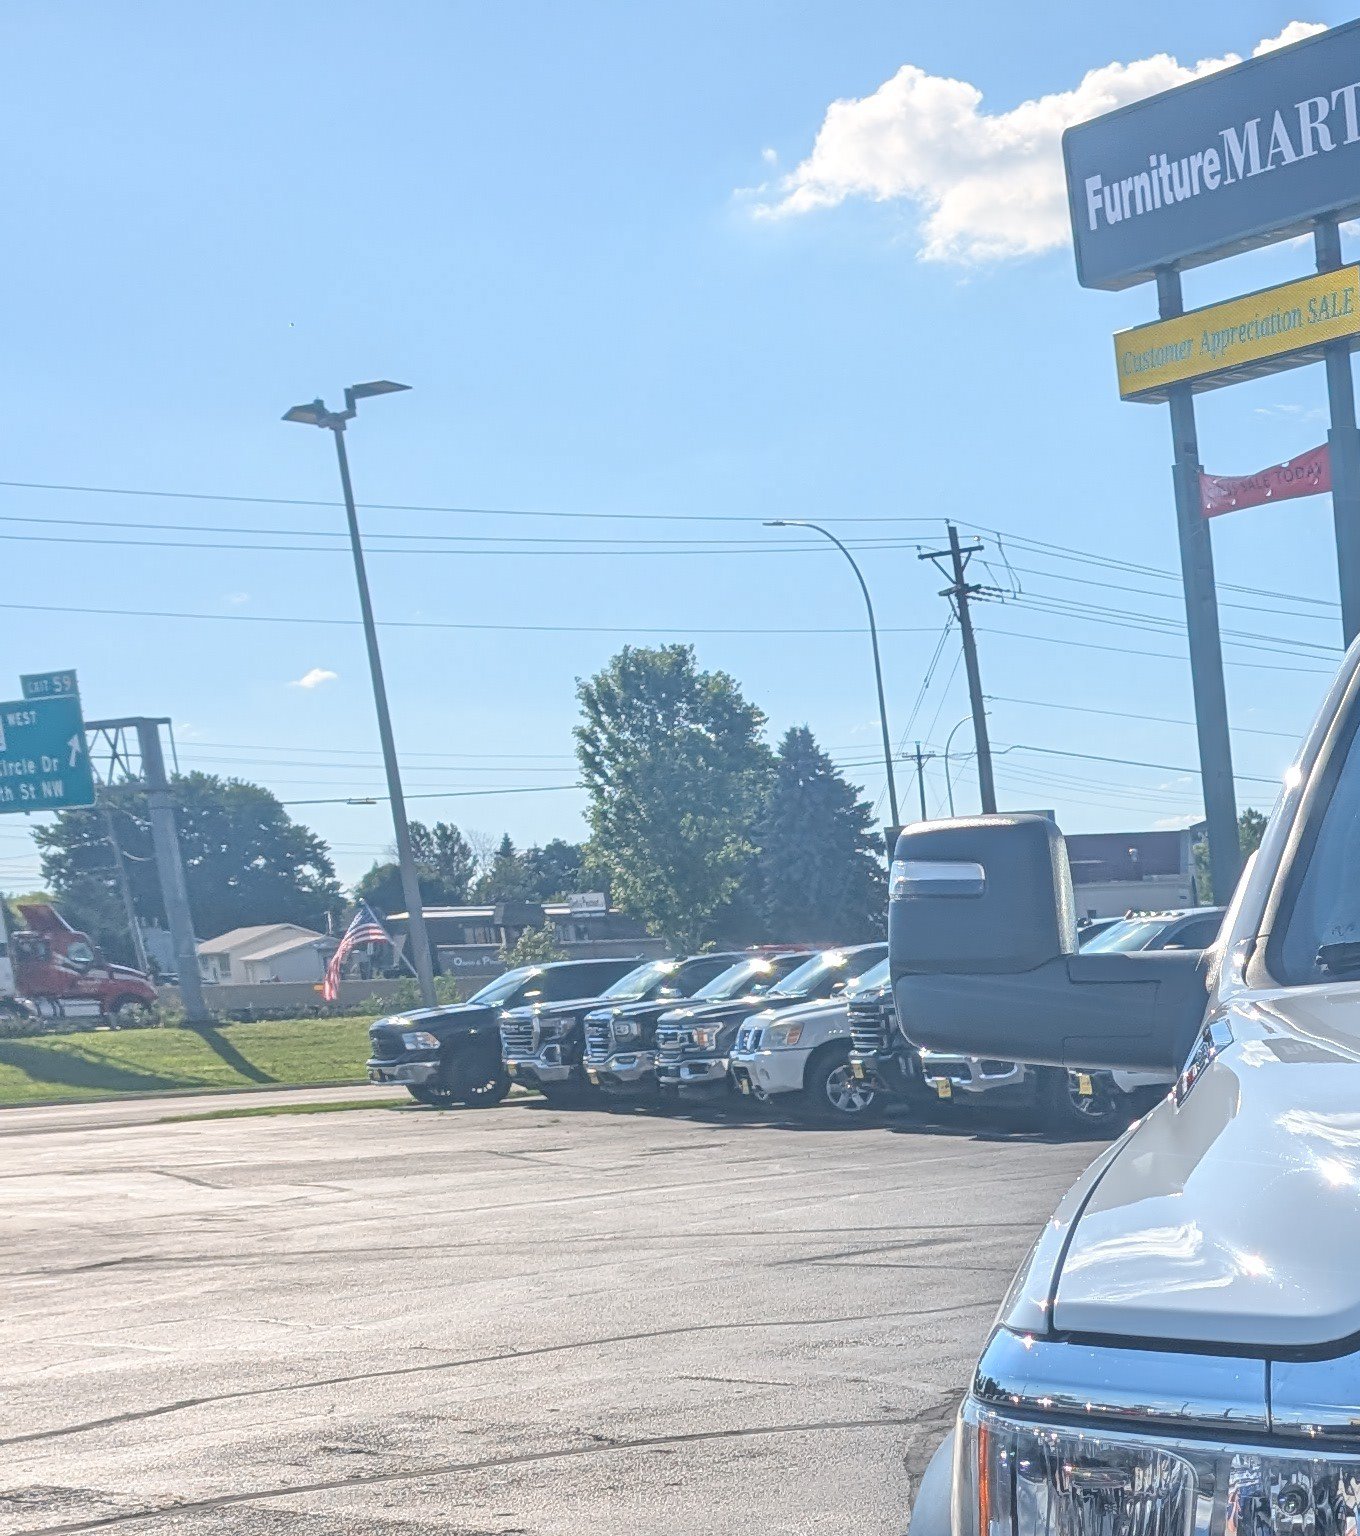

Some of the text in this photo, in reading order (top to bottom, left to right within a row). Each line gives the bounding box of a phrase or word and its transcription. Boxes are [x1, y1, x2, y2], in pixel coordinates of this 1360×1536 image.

[1121, 287, 1355, 376] Customer Appreciation SALE
[7, 711, 37, 726] WEST
[42, 755, 59, 773] Dr
[20, 783, 36, 800] St
[42, 780, 64, 799] NW
